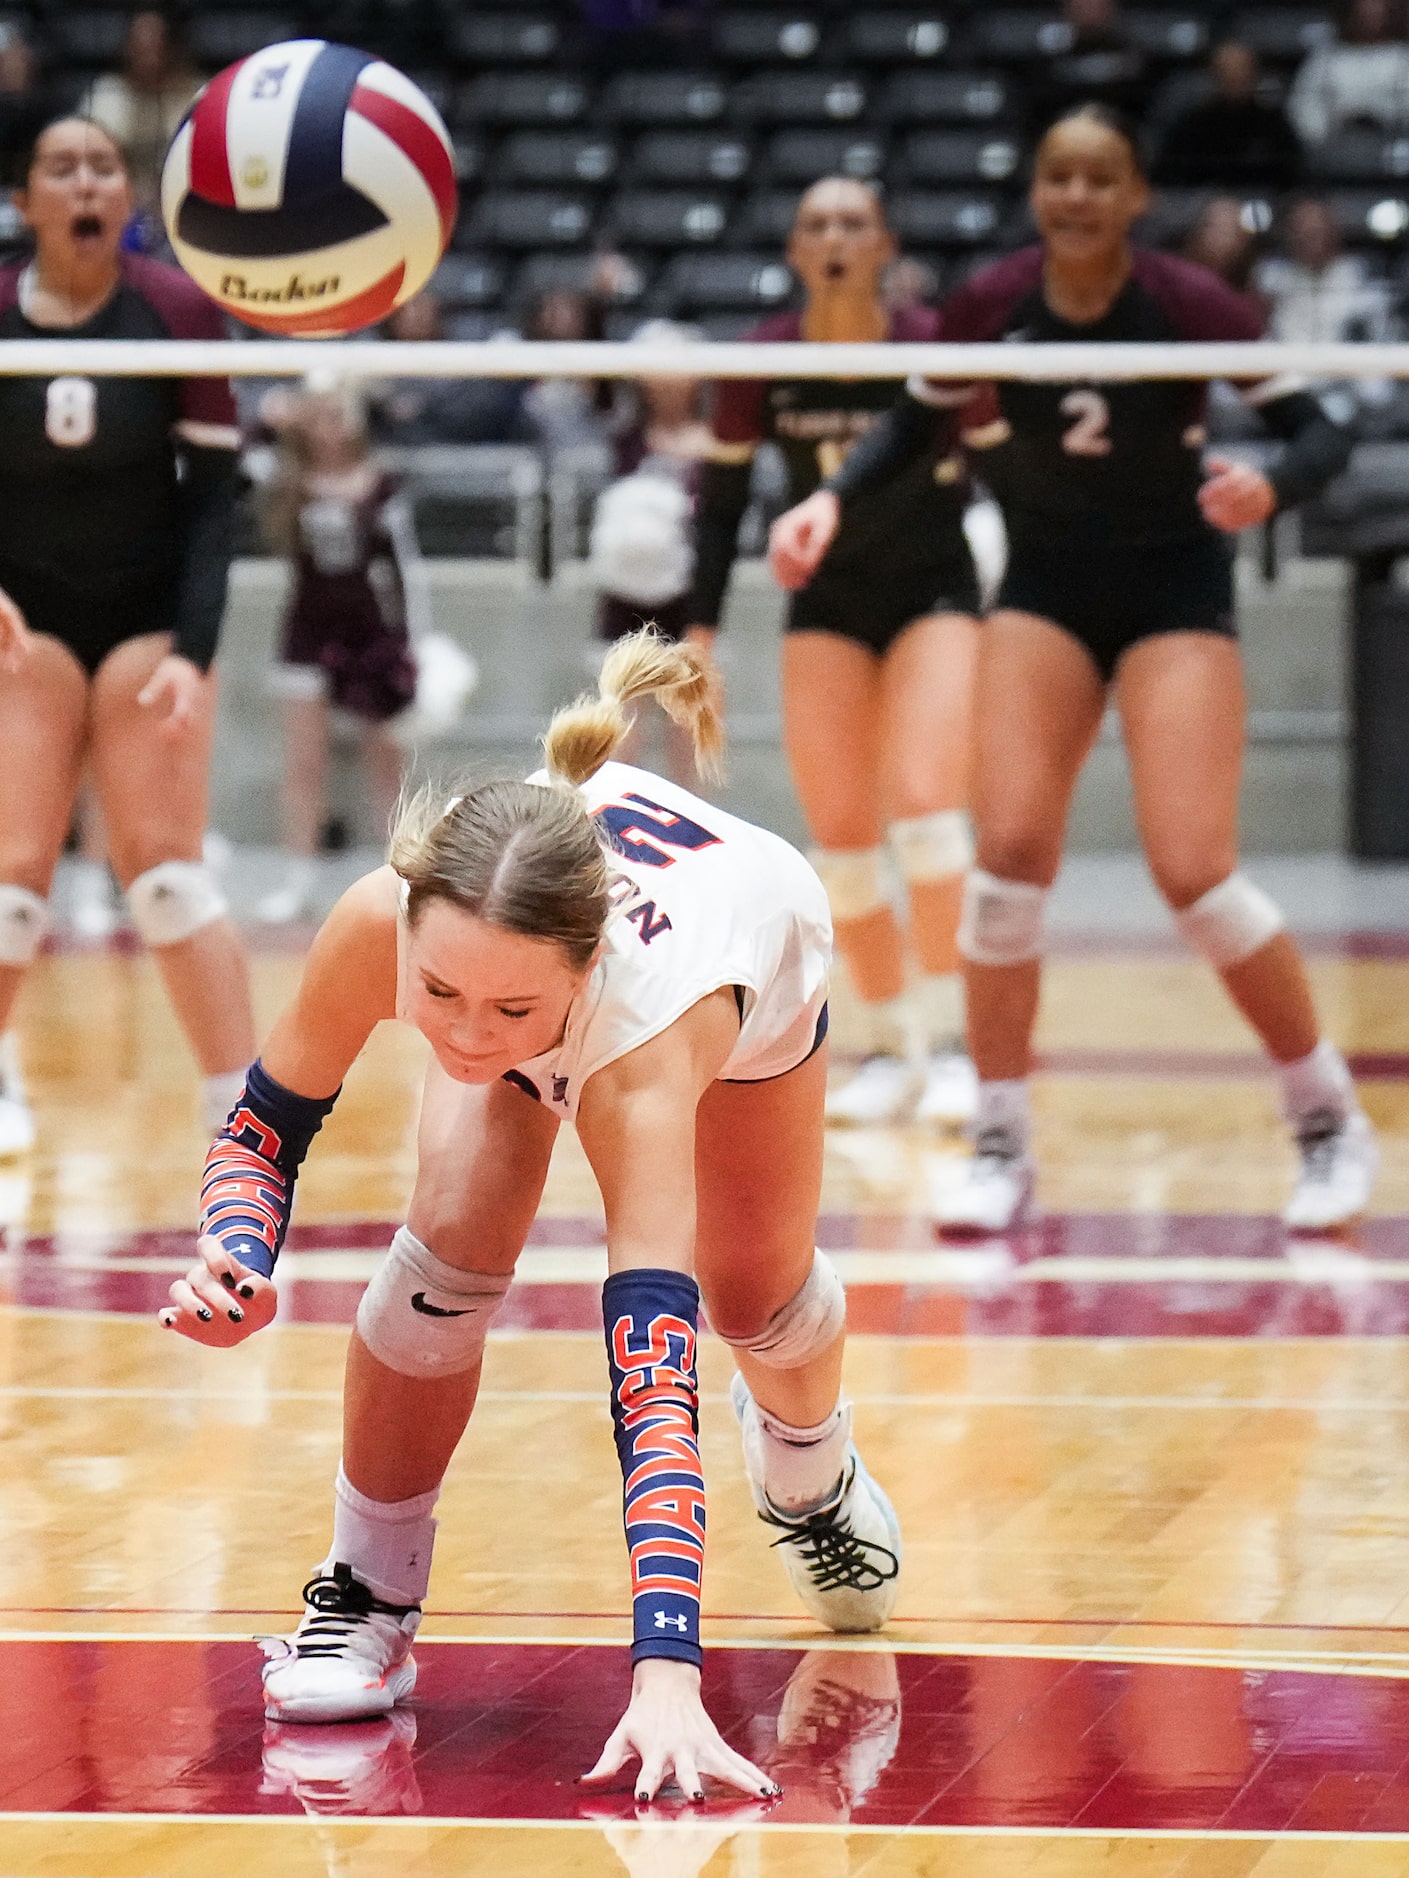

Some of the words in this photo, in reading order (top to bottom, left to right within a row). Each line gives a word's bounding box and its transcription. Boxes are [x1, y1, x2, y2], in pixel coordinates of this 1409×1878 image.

[45, 376, 97, 447] 8
[1059, 389, 1113, 456] 2
[587, 792, 725, 870] 2
[611, 1313, 706, 1600] DAWGS
